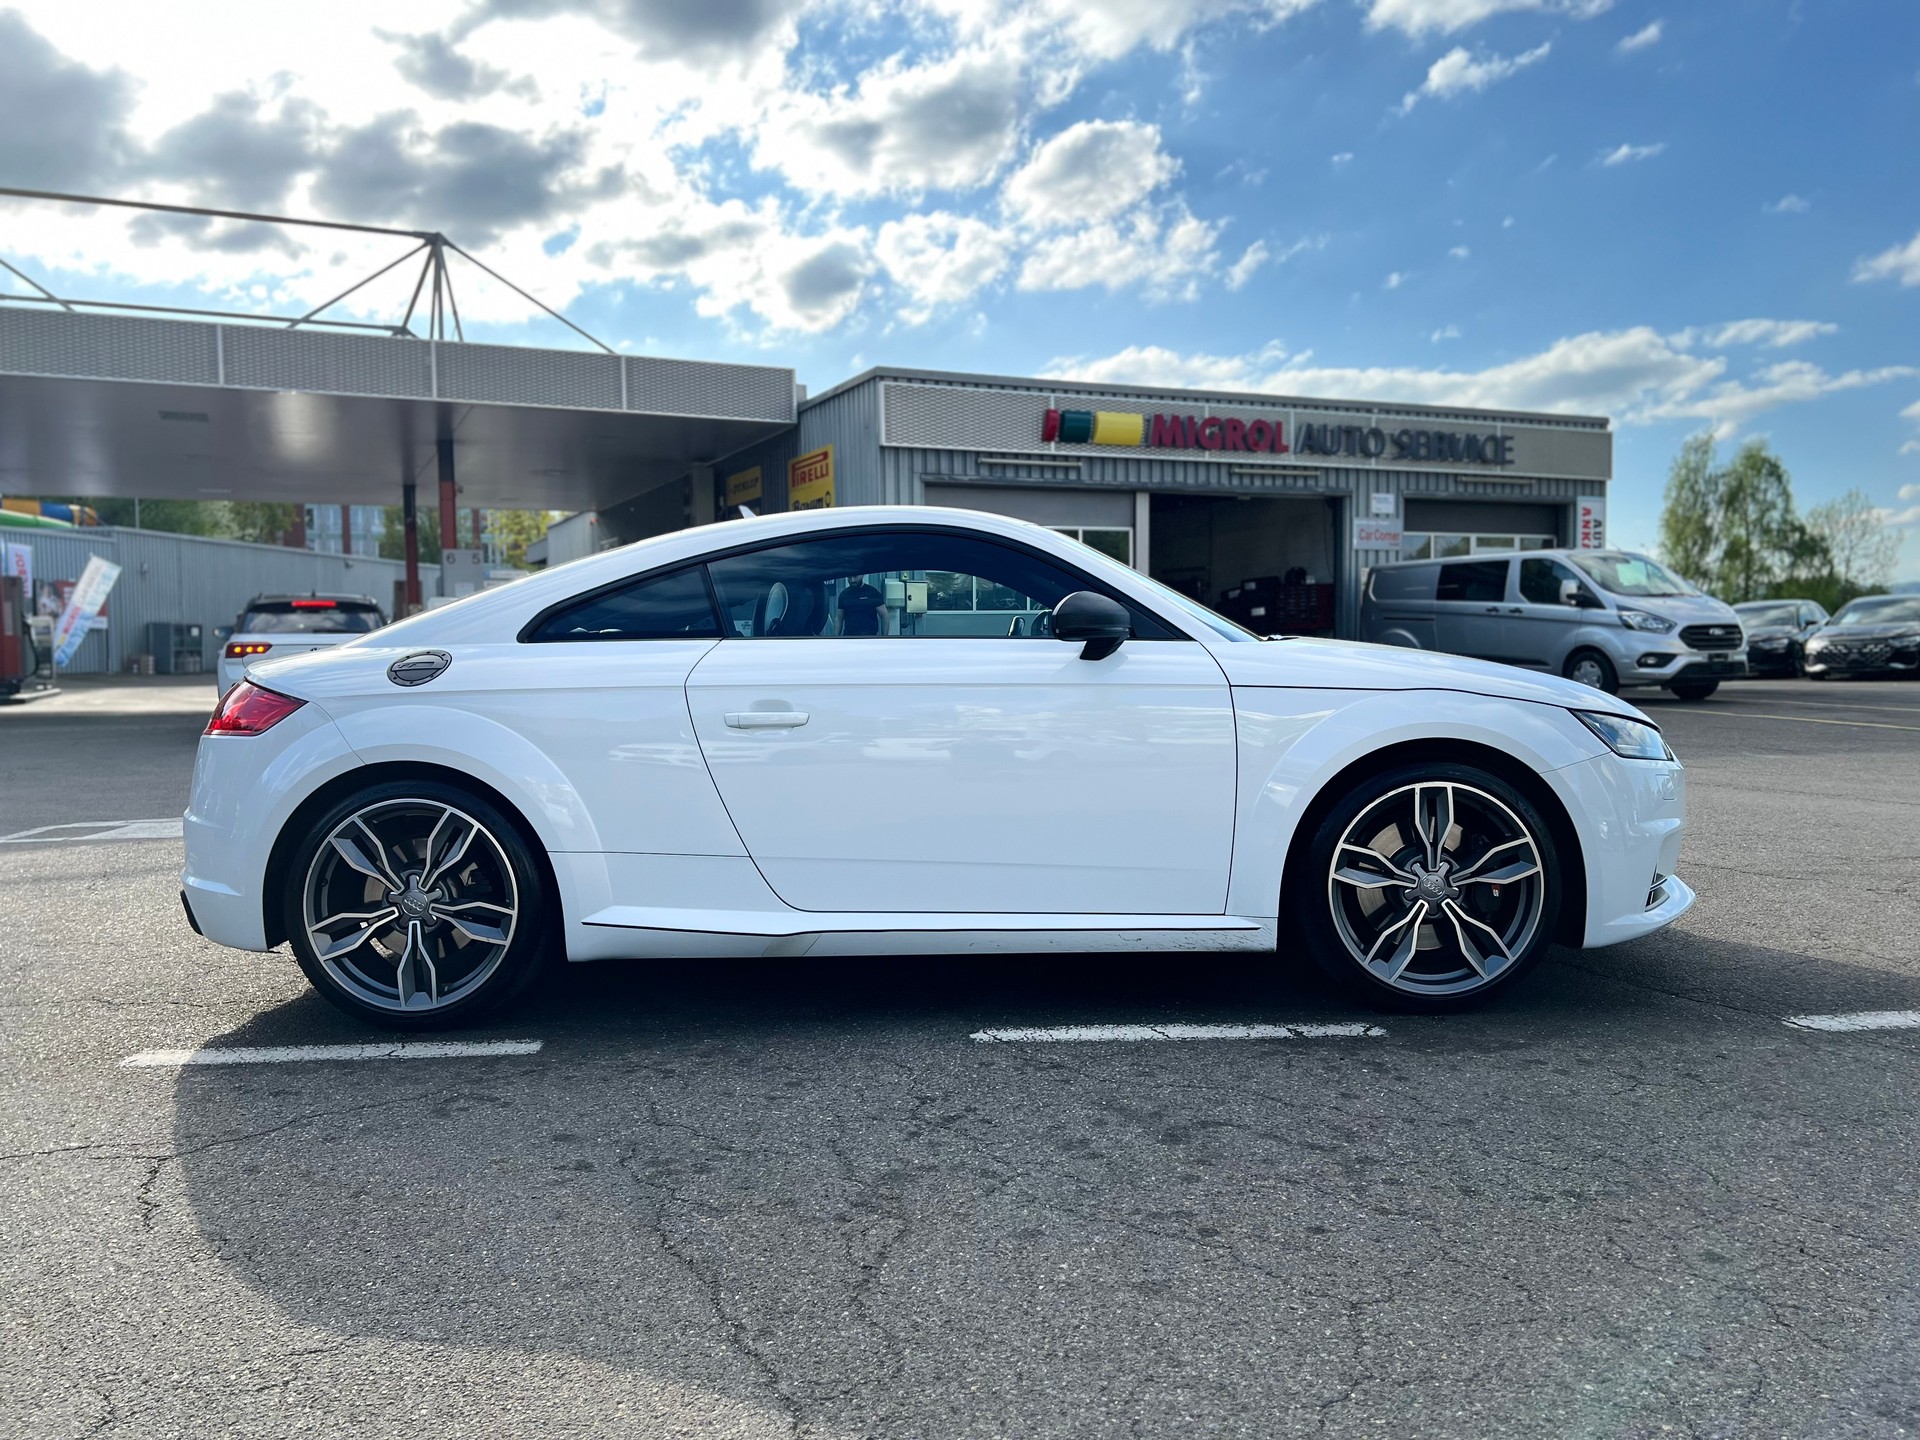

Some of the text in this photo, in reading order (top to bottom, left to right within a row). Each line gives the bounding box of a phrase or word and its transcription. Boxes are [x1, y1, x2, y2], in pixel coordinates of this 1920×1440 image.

[1152, 413, 1516, 466] MIGROL AUTO SERVICE
[791, 451, 829, 488] PIRELLI
[733, 476, 759, 495] DUNLOP
[1359, 528, 1400, 542] Car Corner
[446, 552, 456, 565] 6
[472, 552, 481, 565] 5
